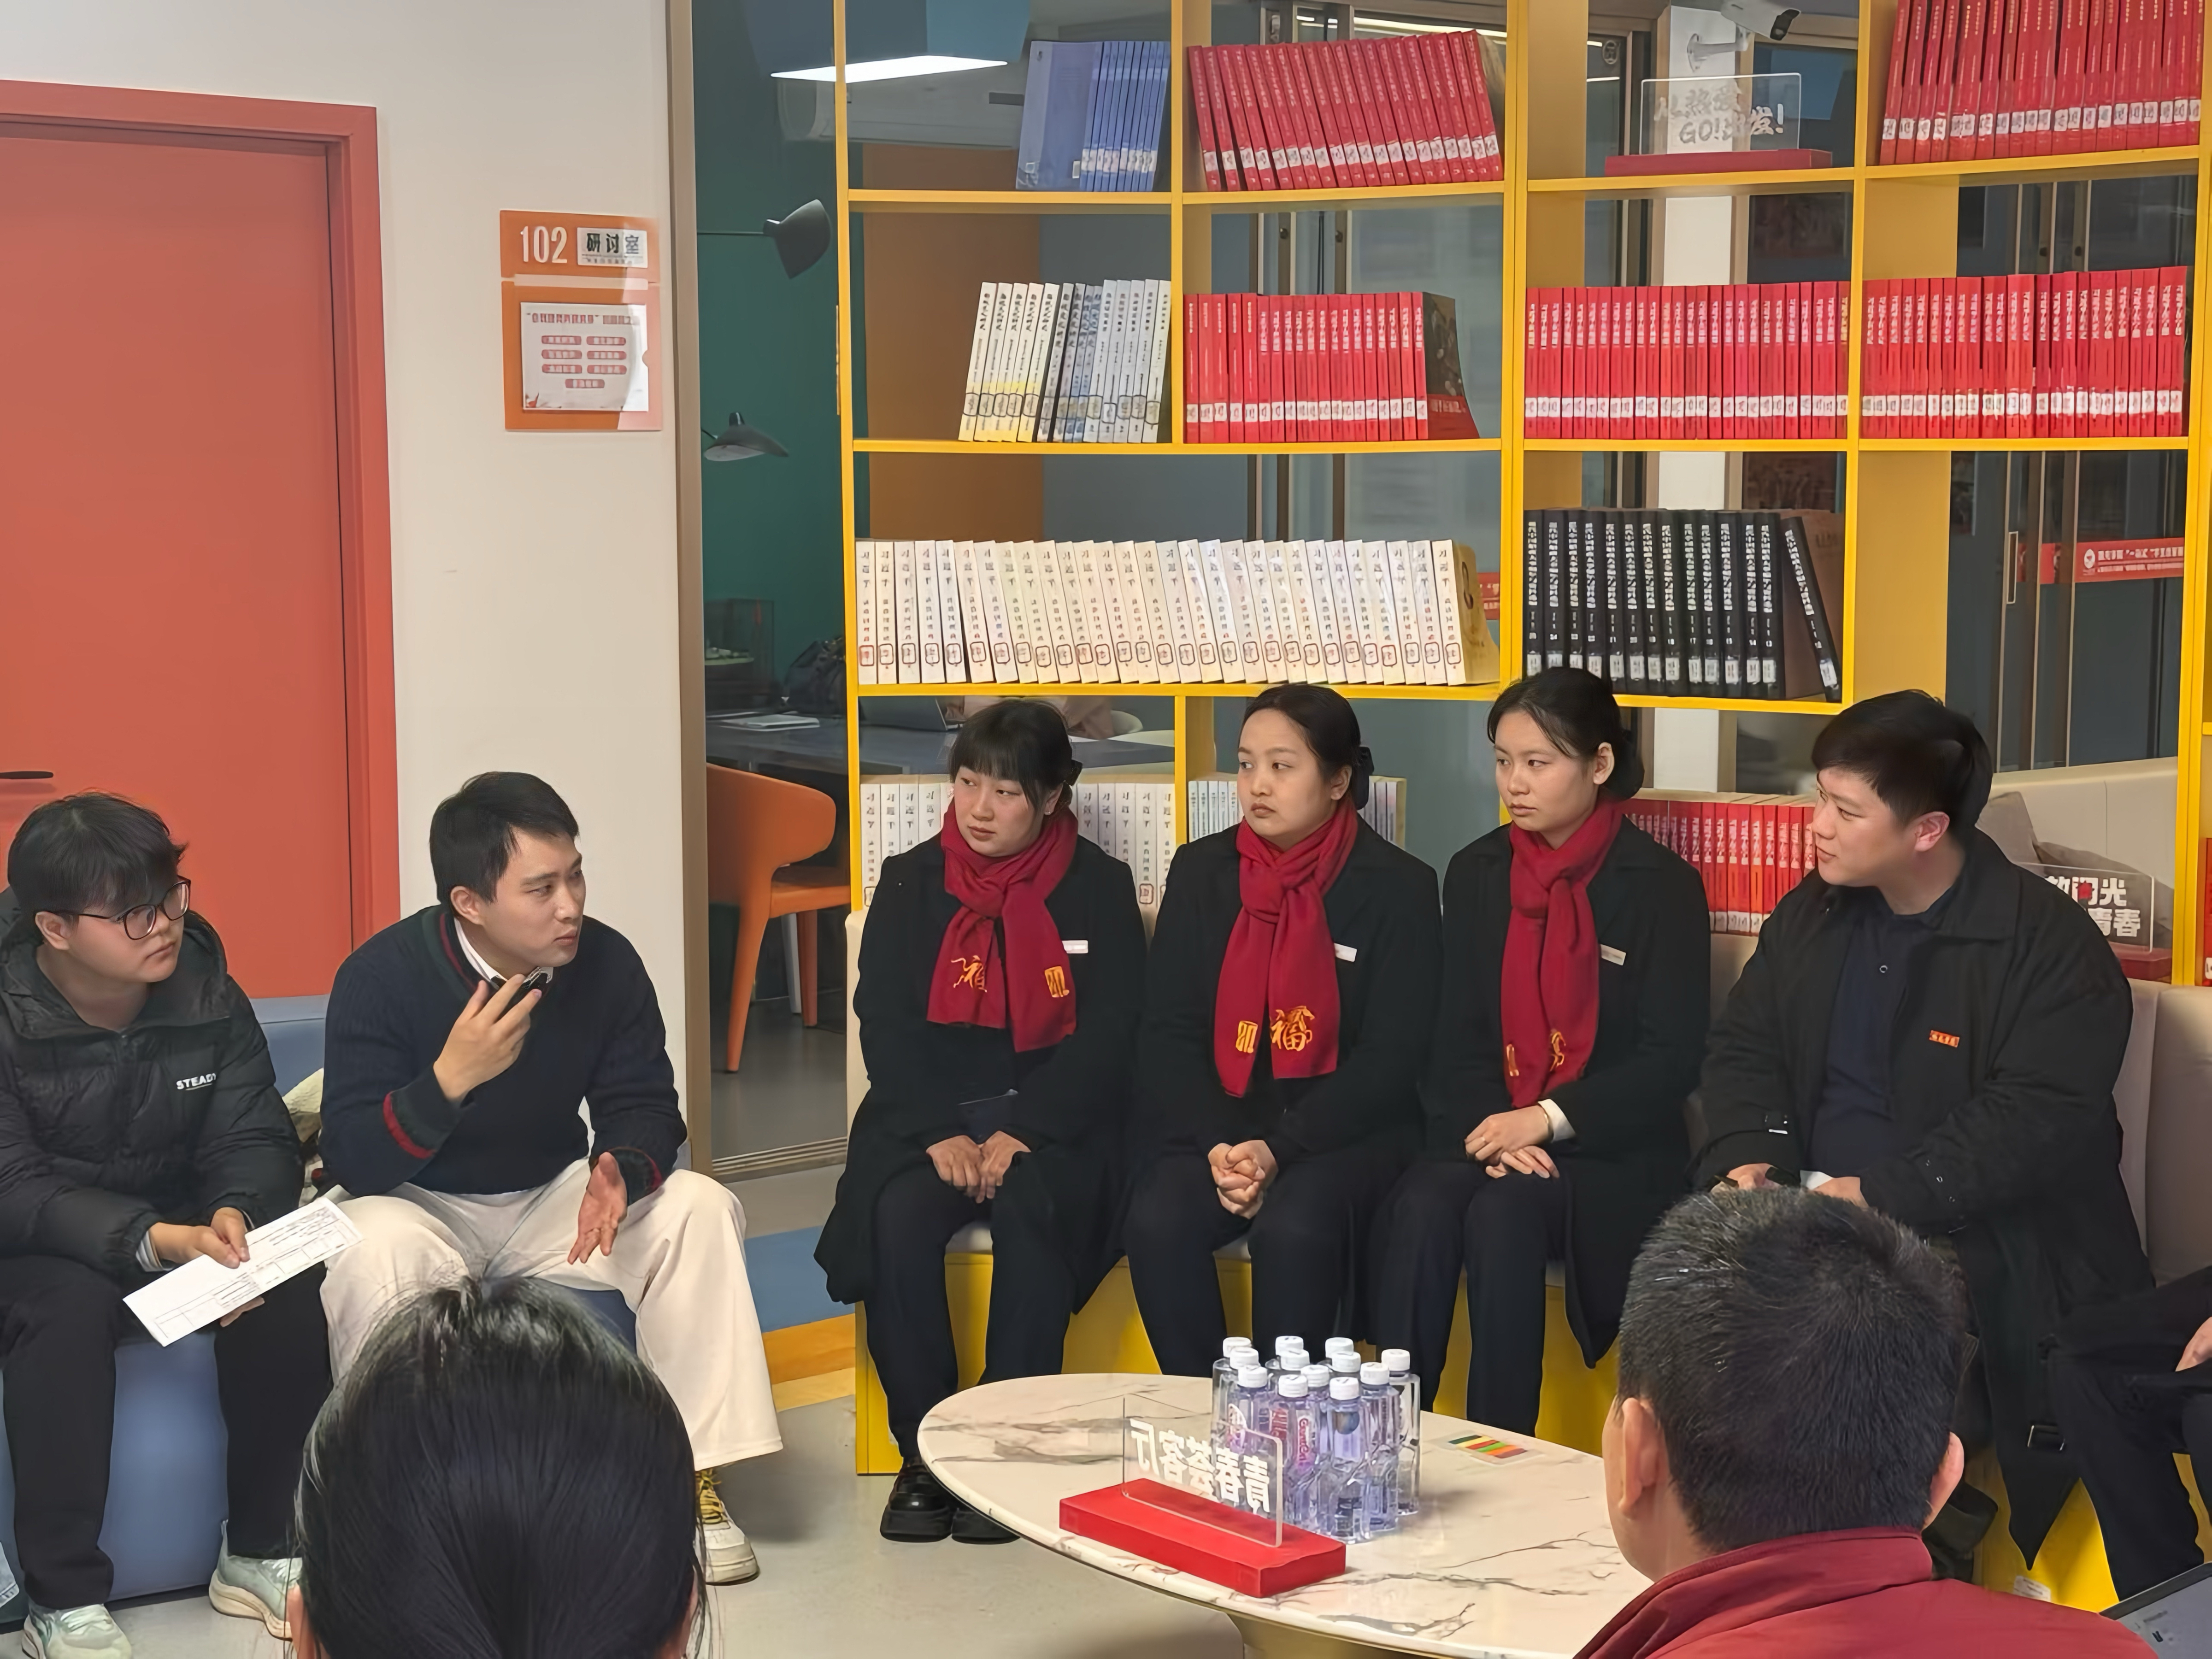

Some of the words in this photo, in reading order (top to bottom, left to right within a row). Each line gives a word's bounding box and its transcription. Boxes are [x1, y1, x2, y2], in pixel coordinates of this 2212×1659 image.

[520, 225, 568, 264] 102
[587, 233, 639, 254] 研讨室
